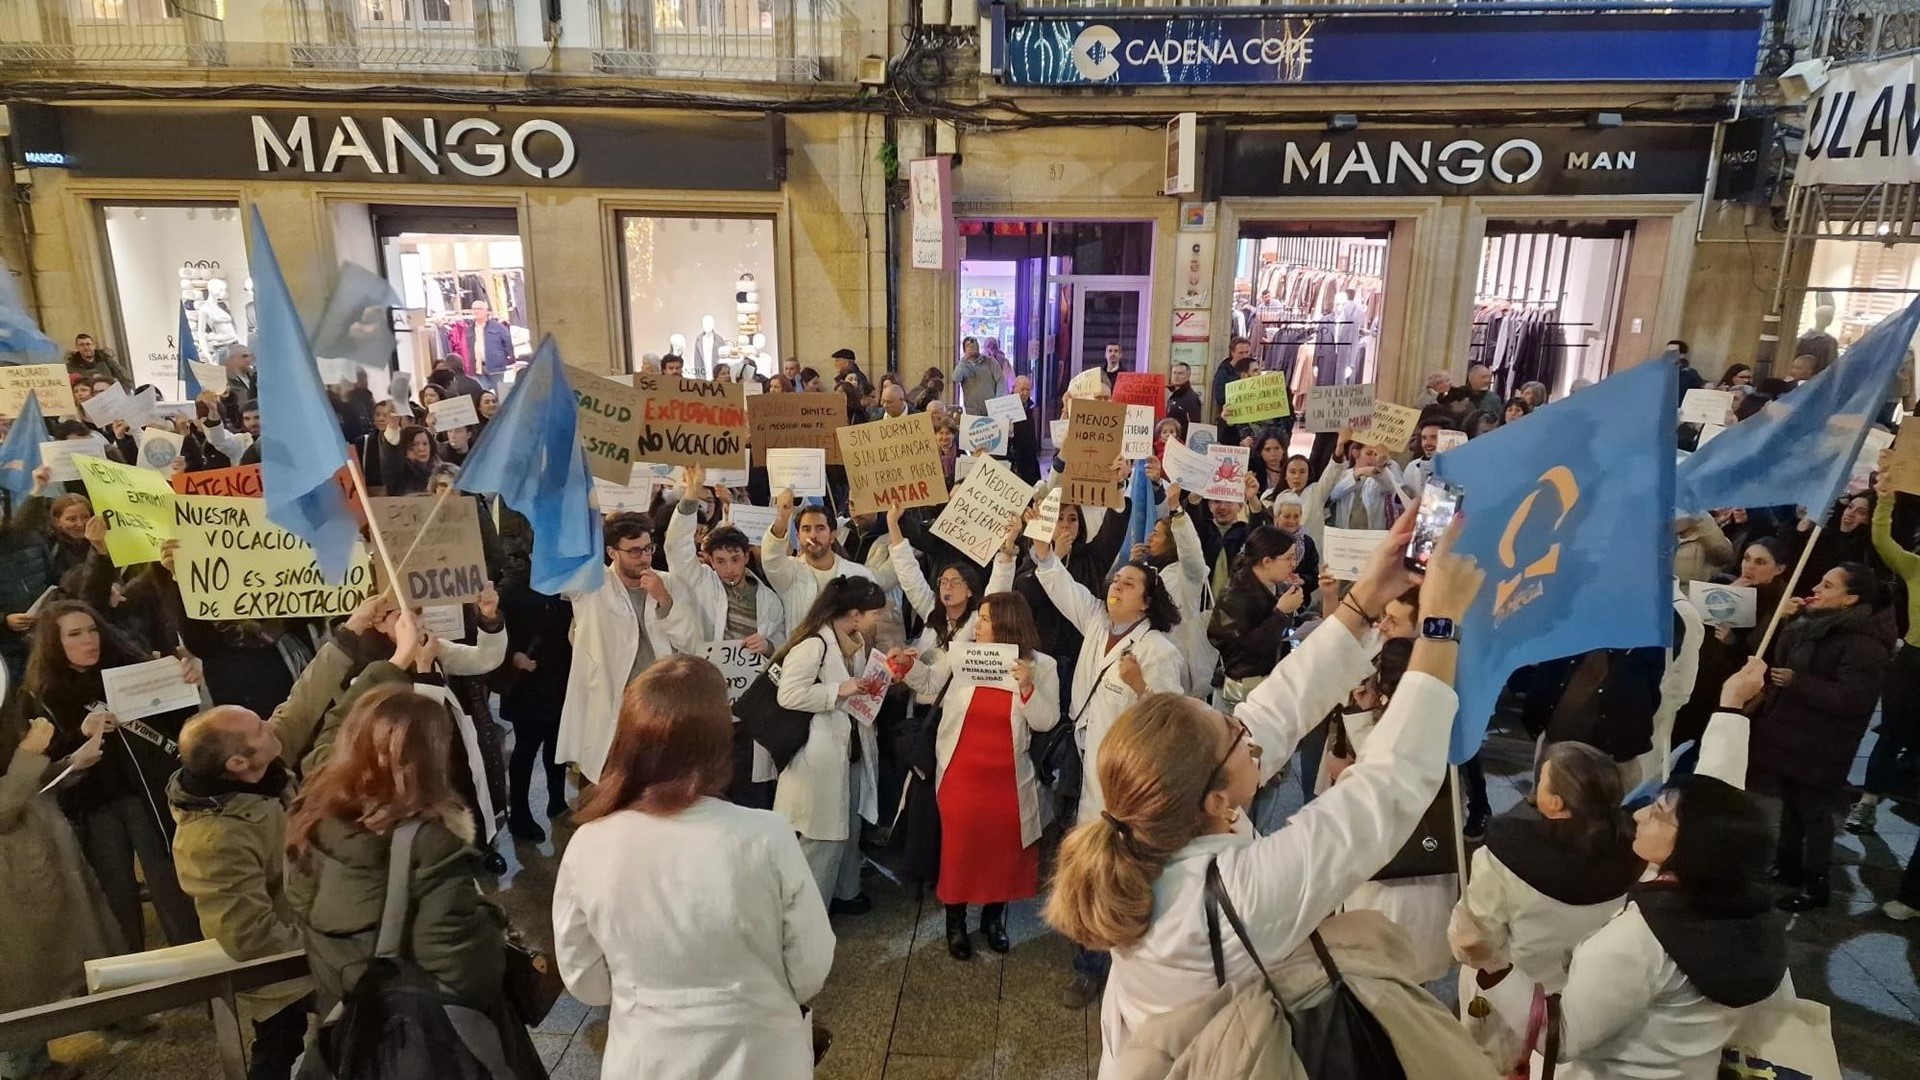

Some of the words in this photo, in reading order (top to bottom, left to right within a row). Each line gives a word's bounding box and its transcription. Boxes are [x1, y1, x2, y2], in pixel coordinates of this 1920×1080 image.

[1125, 39, 1238, 65] CADENA
[1242, 38, 1314, 64] COPE
[24, 152, 65, 164] MANGO
[250, 115, 575, 179] MANGO
[1283, 139, 1543, 185] MANGO
[1568, 151, 1636, 170] MAN
[640, 376, 658, 390] SE
[679, 379, 725, 397] LLAMA
[573, 389, 632, 422] SALUD
[850, 429, 872, 446] SIN
[879, 419, 921, 440] DORMIR
[1075, 413, 1118, 428] MENOS
[1125, 424, 1149, 436] TIENDO
[583, 436, 630, 463] STRA
[638, 424, 663, 455] NO
[666, 425, 739, 456] VOCACIÓN
[1075, 431, 1114, 443] HORAS
[853, 449, 876, 467] SIN
[878, 439, 932, 462] DESCANSAR
[185, 469, 264, 496] ATENCI
[853, 474, 869, 490] UN
[874, 467, 904, 486] ERROR
[910, 461, 937, 480] PUEDE
[976, 462, 1025, 507] MÉDICOS
[873, 481, 929, 507] MATAR
[175, 501, 250, 527] NUESTRA
[955, 516, 967, 526] EN
[937, 518, 977, 546] RIESGO
[191, 556, 230, 594] NO
[243, 570, 265, 588] ES
[408, 564, 484, 600] DIGNA
[200, 601, 220, 618] DE
